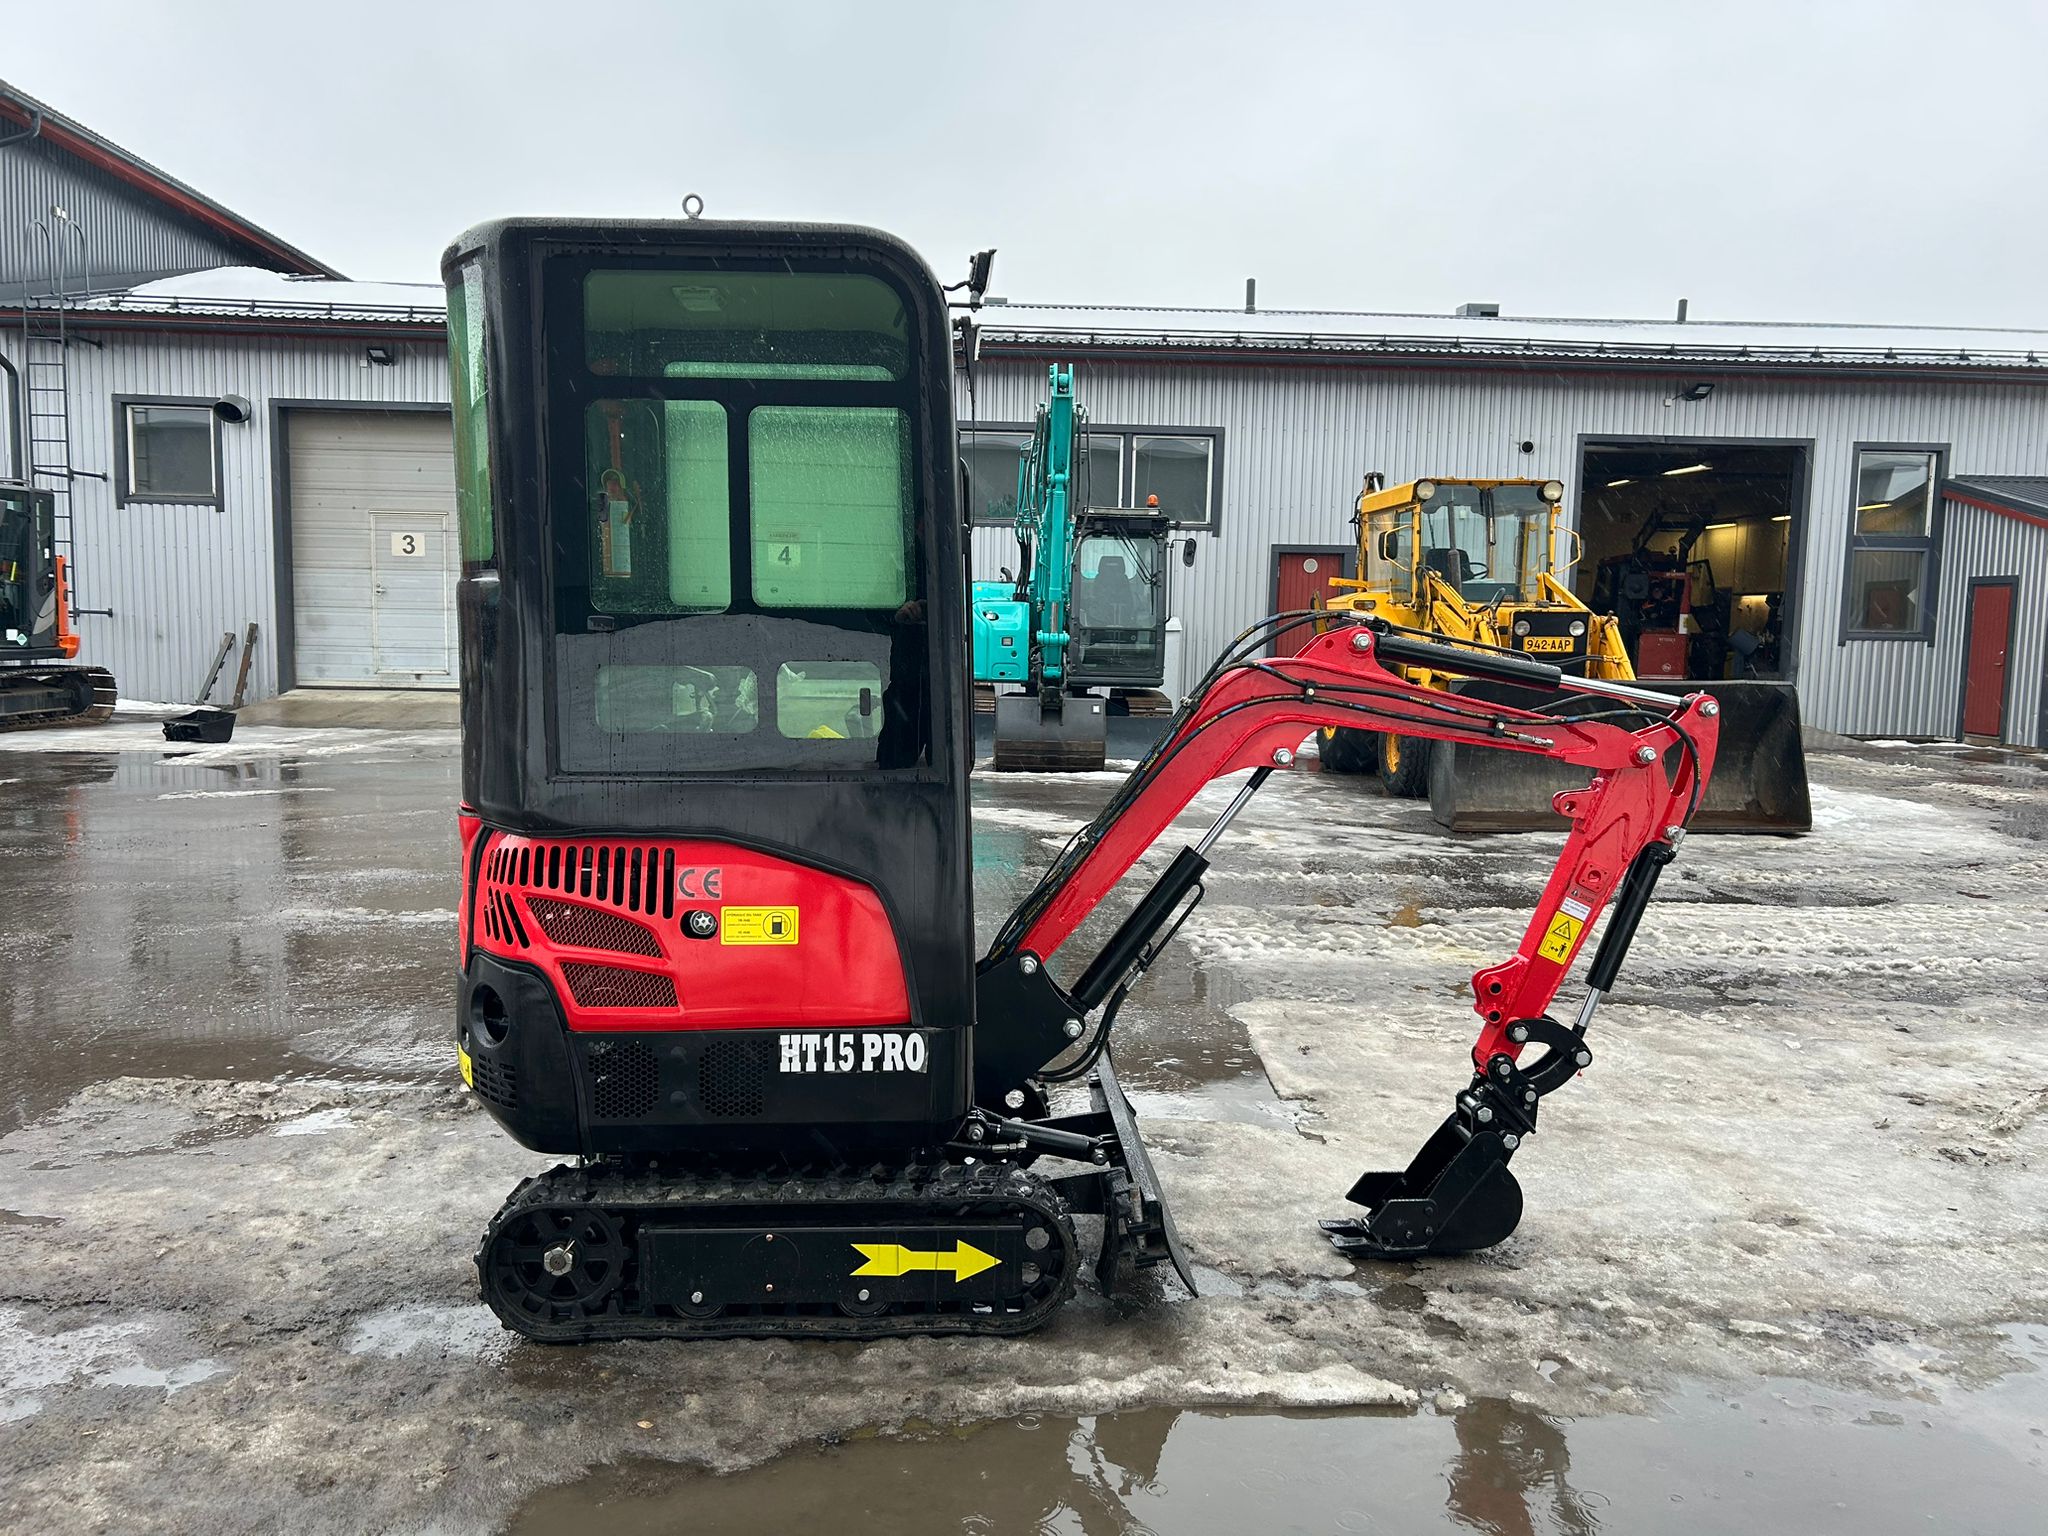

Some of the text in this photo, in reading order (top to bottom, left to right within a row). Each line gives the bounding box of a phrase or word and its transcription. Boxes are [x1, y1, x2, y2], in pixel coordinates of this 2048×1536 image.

[402, 534, 416, 555] 3
[777, 545, 792, 566] 4
[1527, 639, 1571, 650] 942-AAP
[678, 869, 720, 898] CE
[779, 1032, 925, 1073] HT15 PRO
